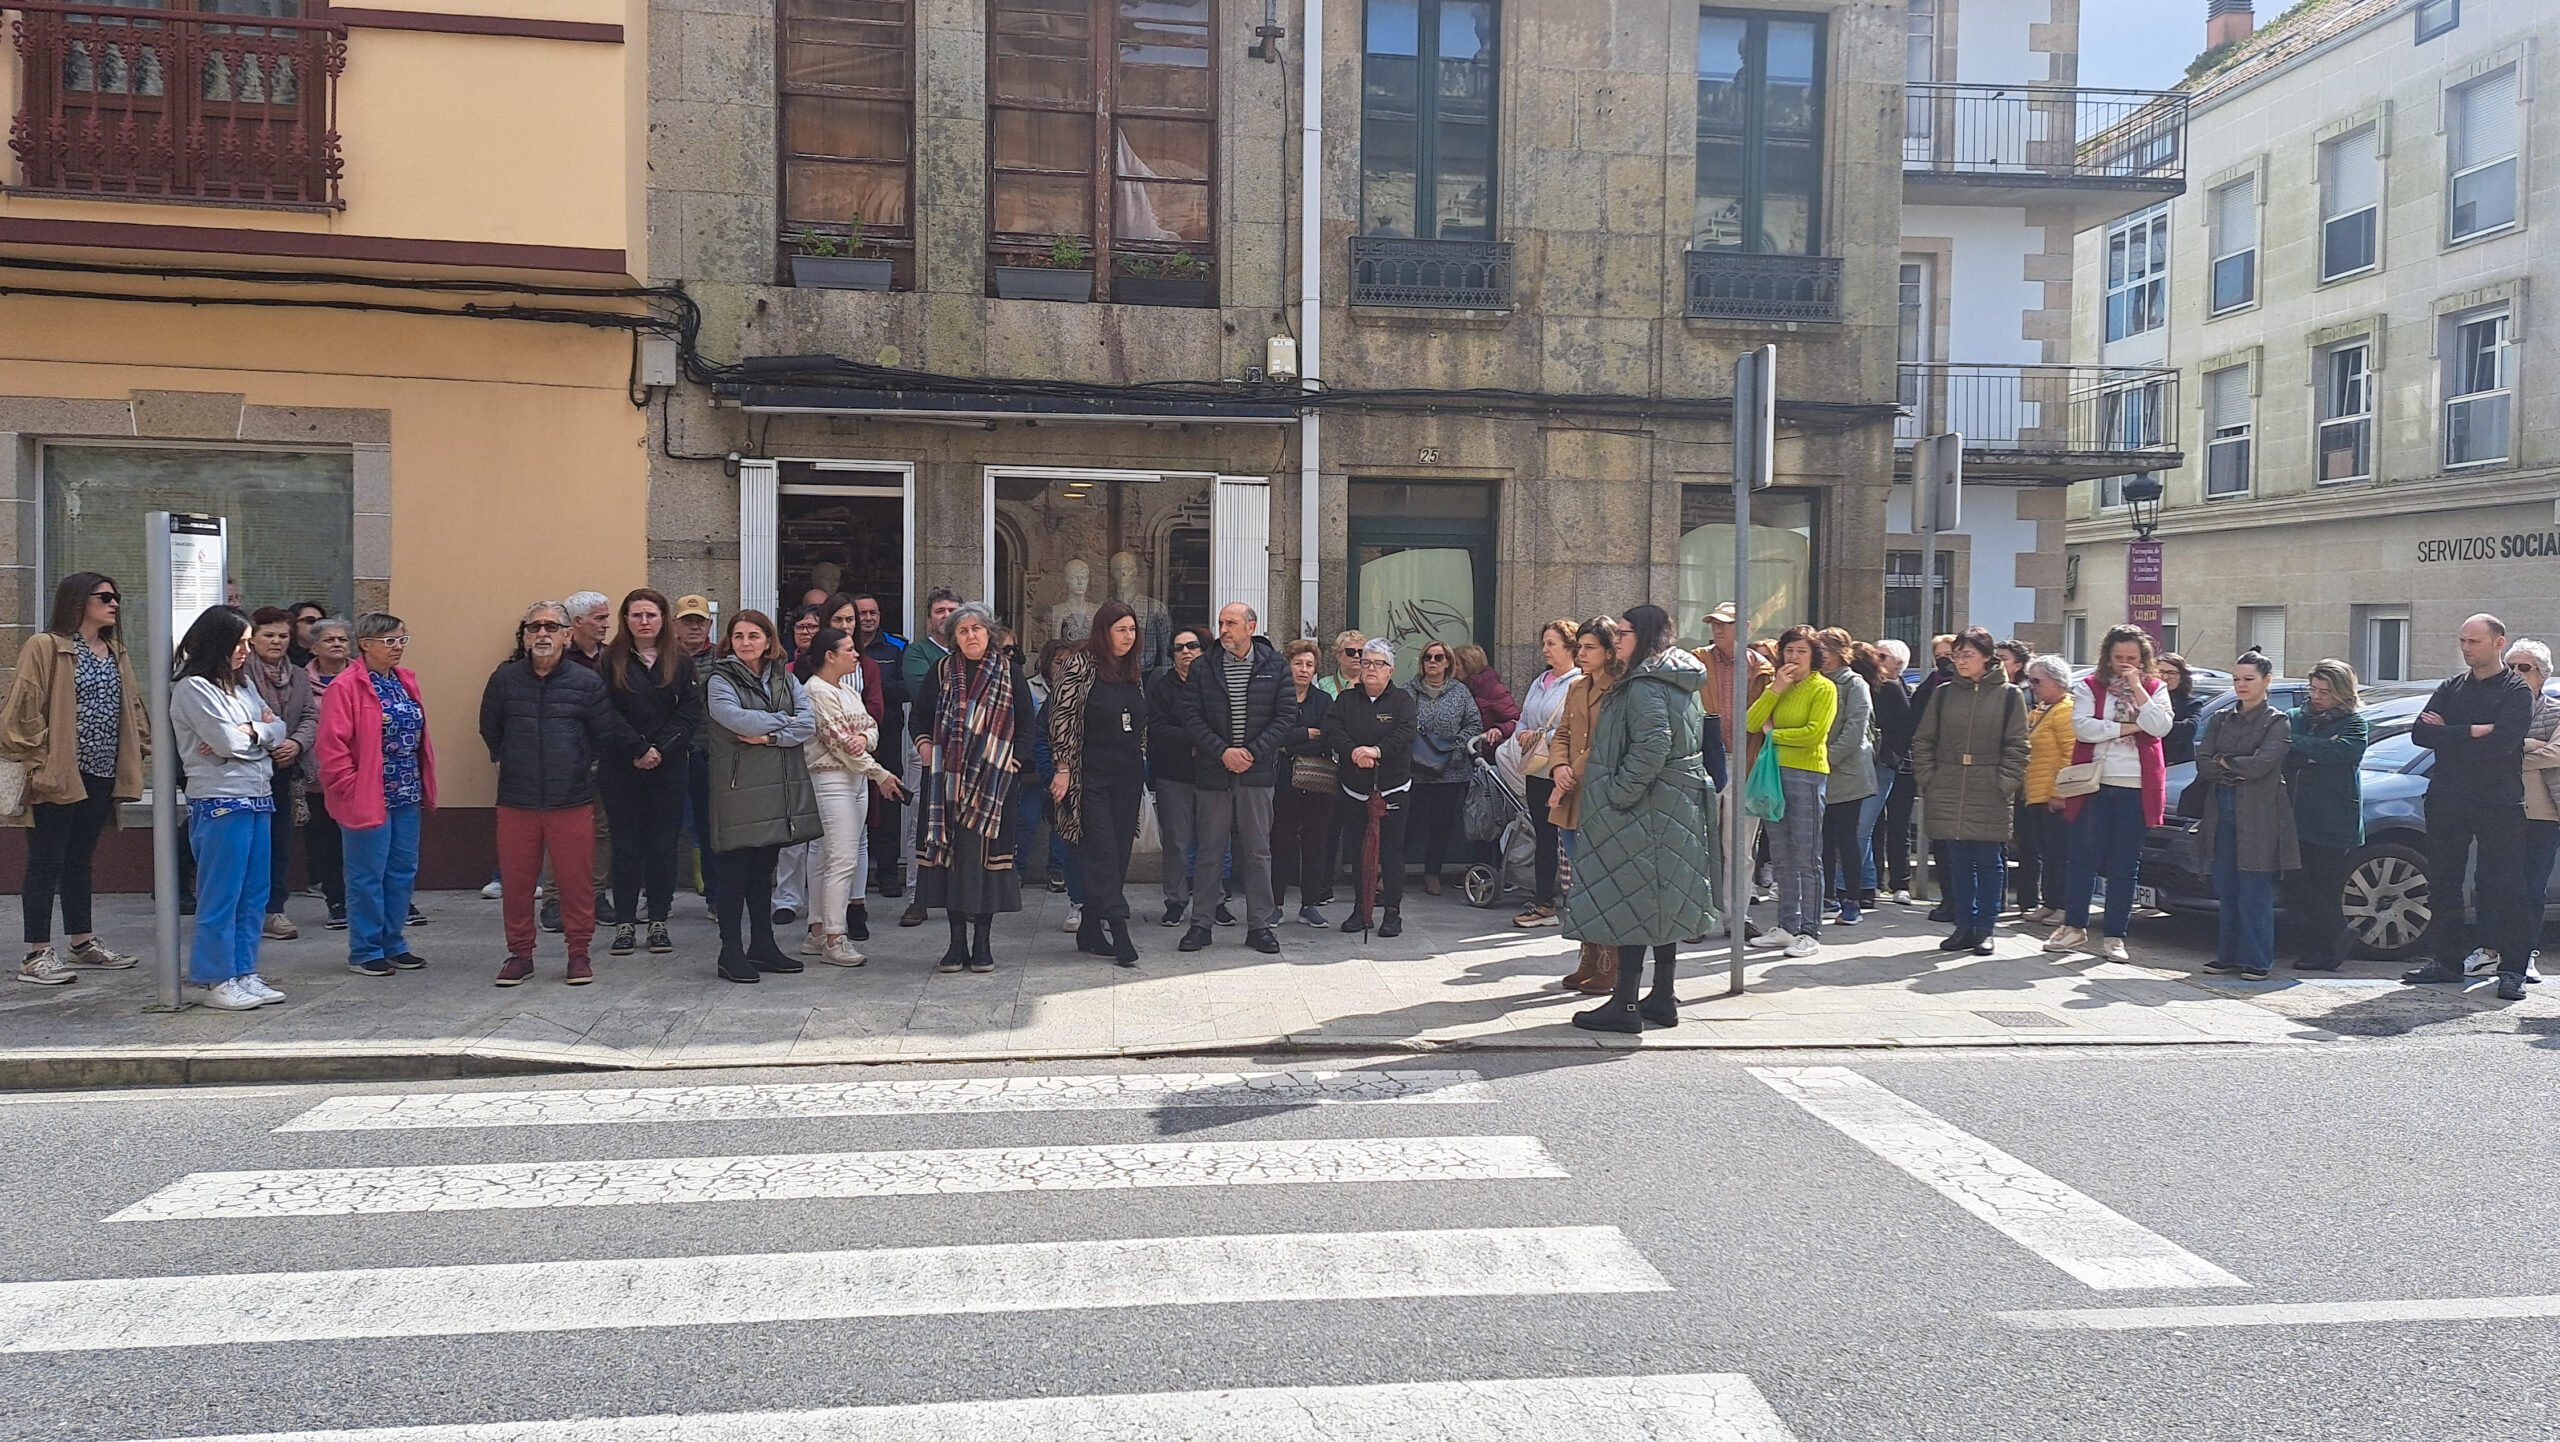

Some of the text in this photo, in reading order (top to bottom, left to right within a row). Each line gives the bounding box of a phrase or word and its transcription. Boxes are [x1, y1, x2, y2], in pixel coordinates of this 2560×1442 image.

[1420, 448, 1439, 463] 25
[2417, 532, 2560, 563] SERVIZOS SOCIA
[2130, 593, 2161, 606] SEMANA
[2135, 610, 2157, 621] SANTA
